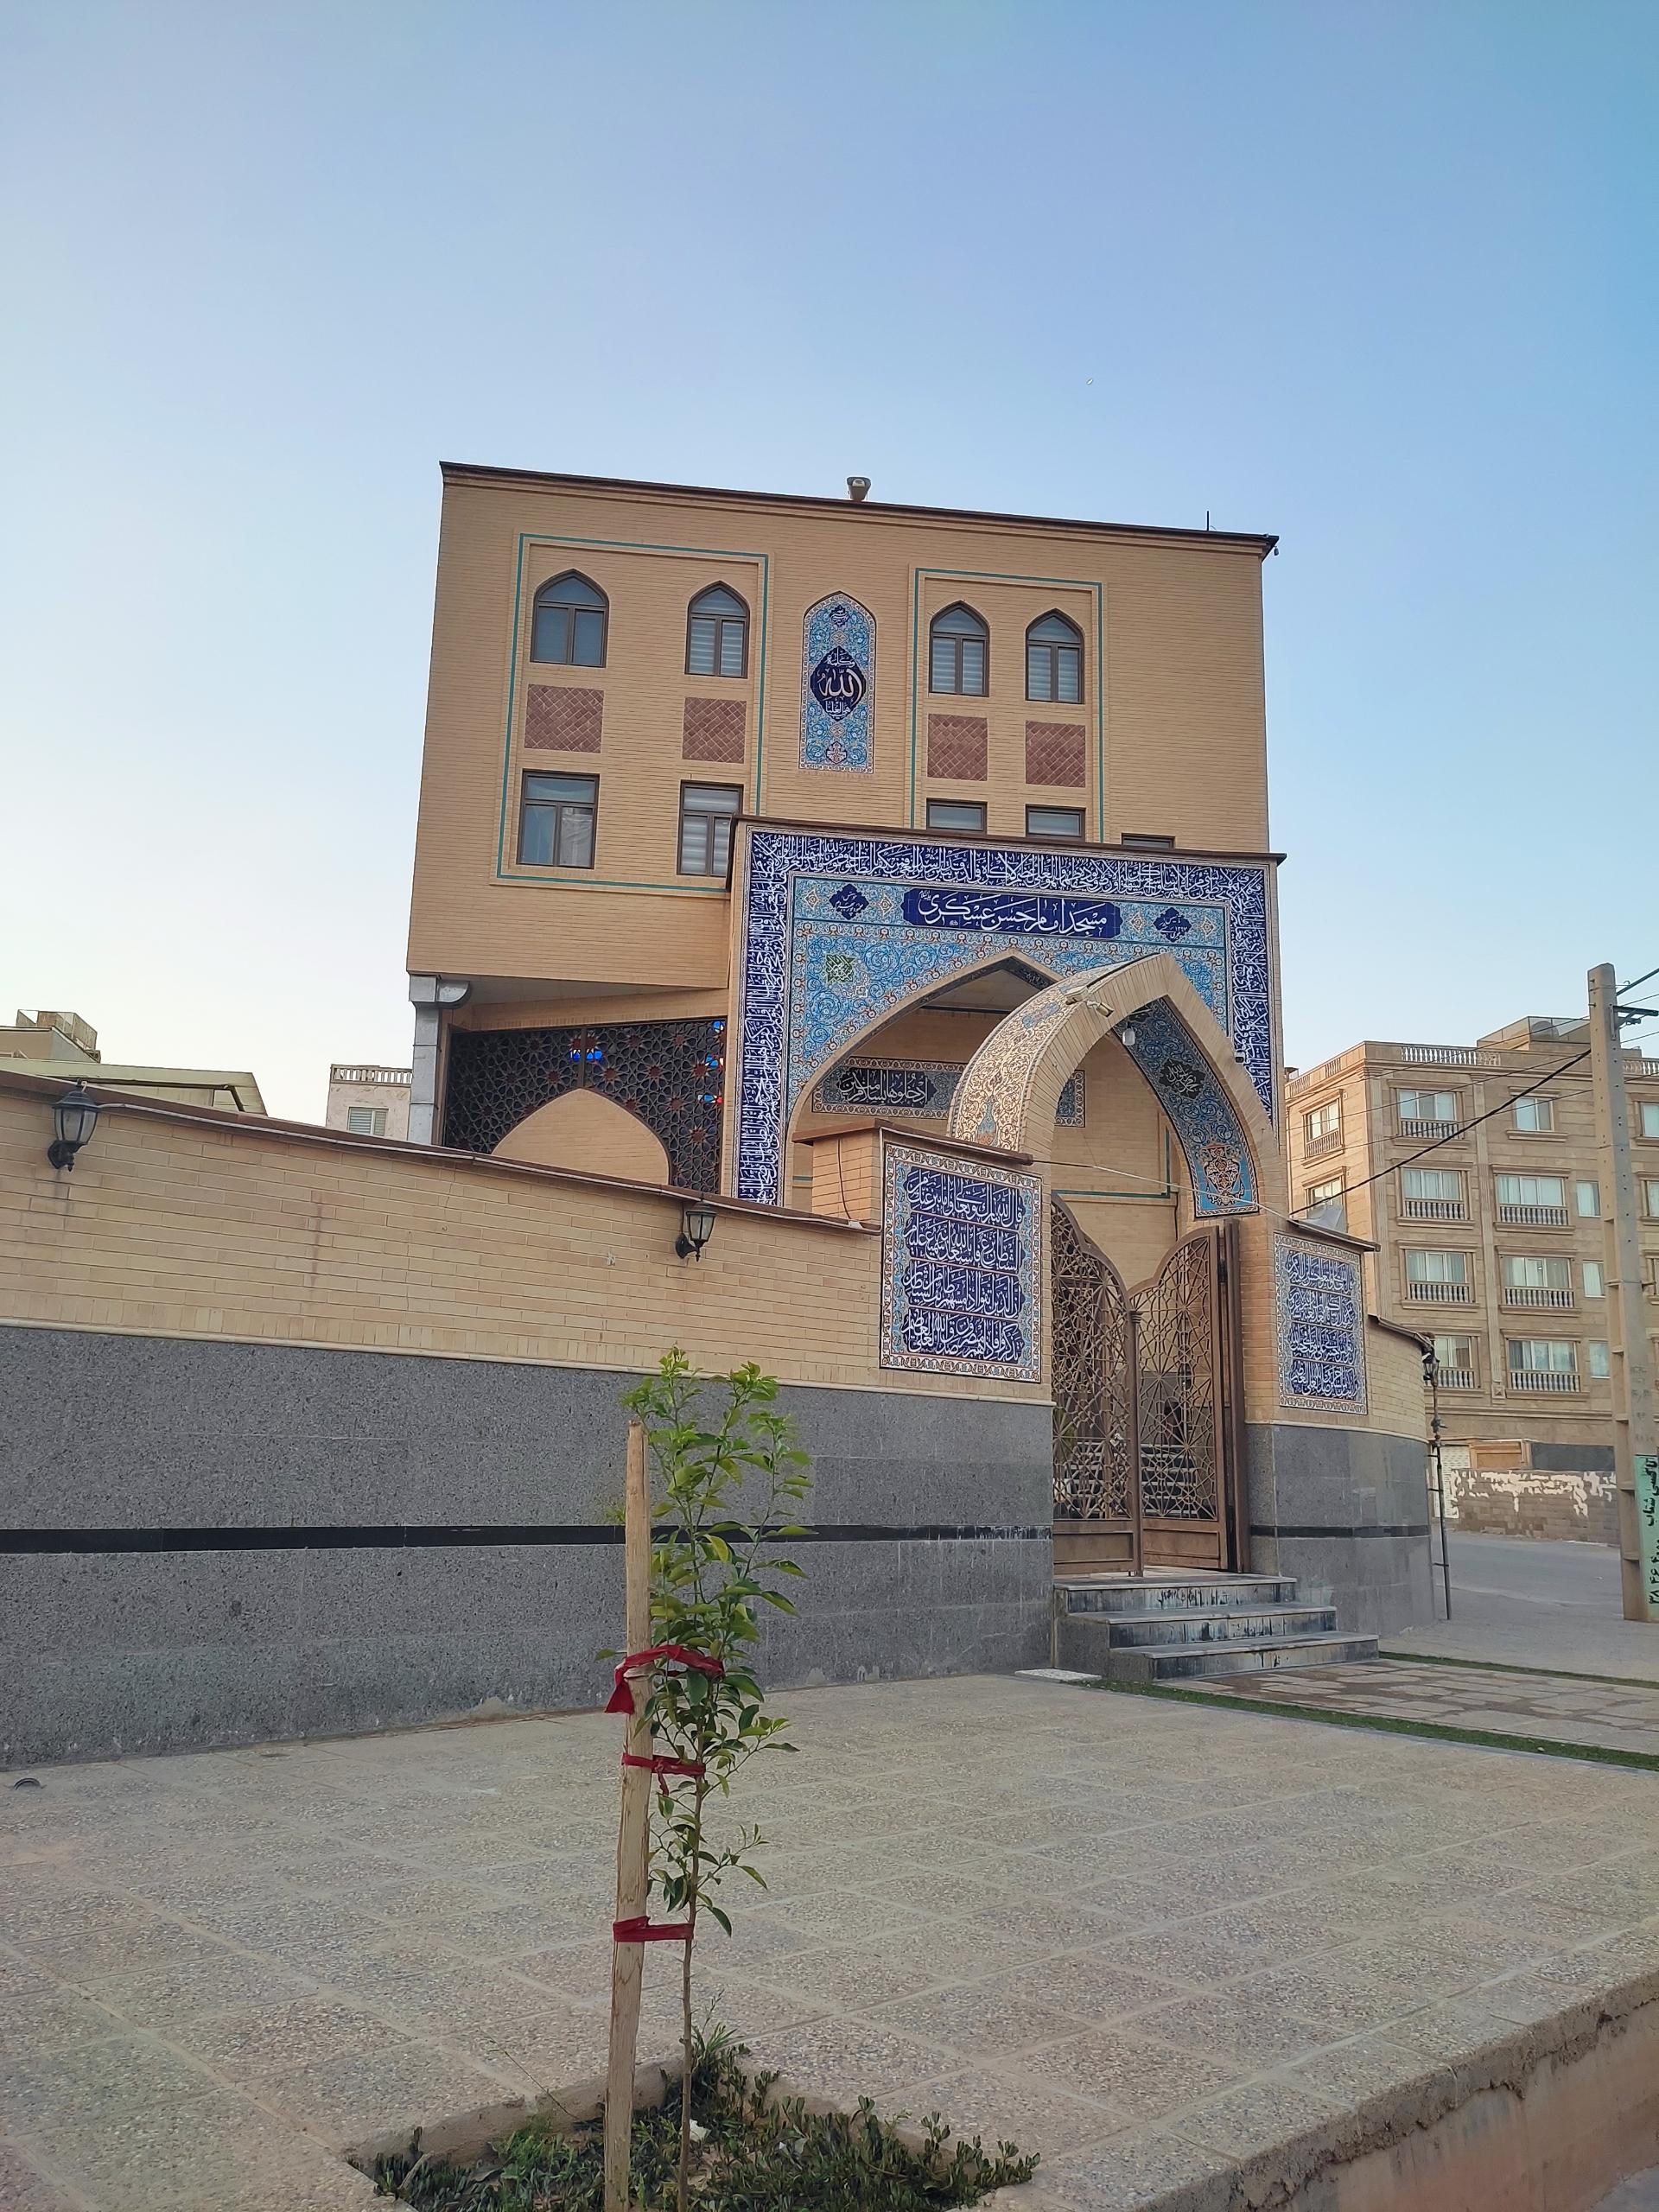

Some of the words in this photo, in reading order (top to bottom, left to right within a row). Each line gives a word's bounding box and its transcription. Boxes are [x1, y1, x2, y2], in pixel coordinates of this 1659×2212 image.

[817, 667, 862, 707] الله
[980, 897, 1037, 931] حسن
[1023, 896, 1066, 934] امام
[1065, 901, 1108, 938] مسجد
